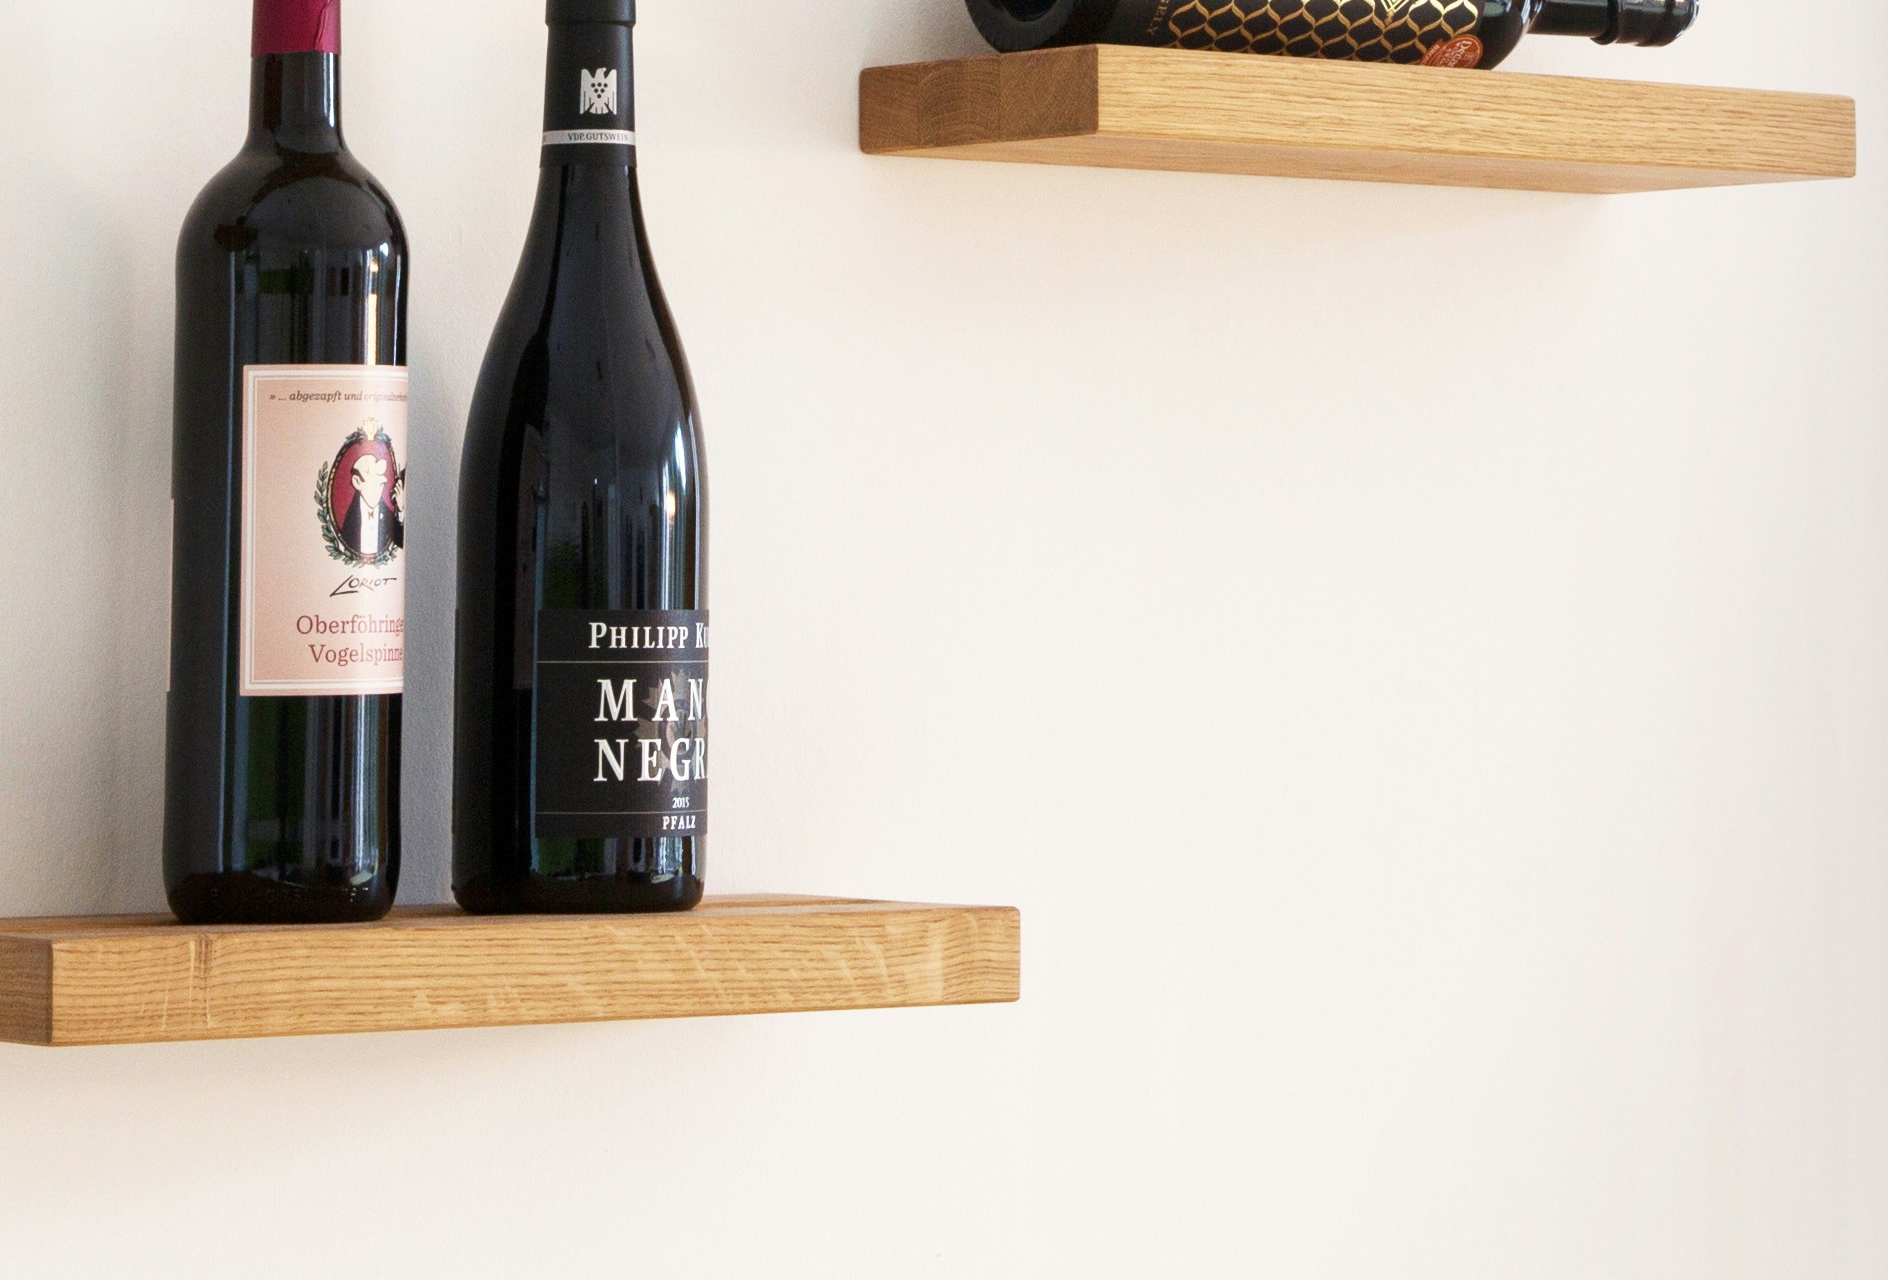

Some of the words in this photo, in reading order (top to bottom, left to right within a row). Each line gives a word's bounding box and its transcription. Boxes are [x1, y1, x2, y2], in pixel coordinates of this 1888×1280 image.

[289, 390, 342, 403] abgezapft
[344, 390, 363, 402] und
[329, 574, 397, 598] LORIOT
[588, 622, 690, 649] PHILIPP
[308, 642, 403, 667] Vogelspinne
[594, 678, 710, 722] MAN
[593, 738, 708, 782] NEGR
[672, 796, 690, 810] 2015
[662, 815, 696, 831] PFALZ
